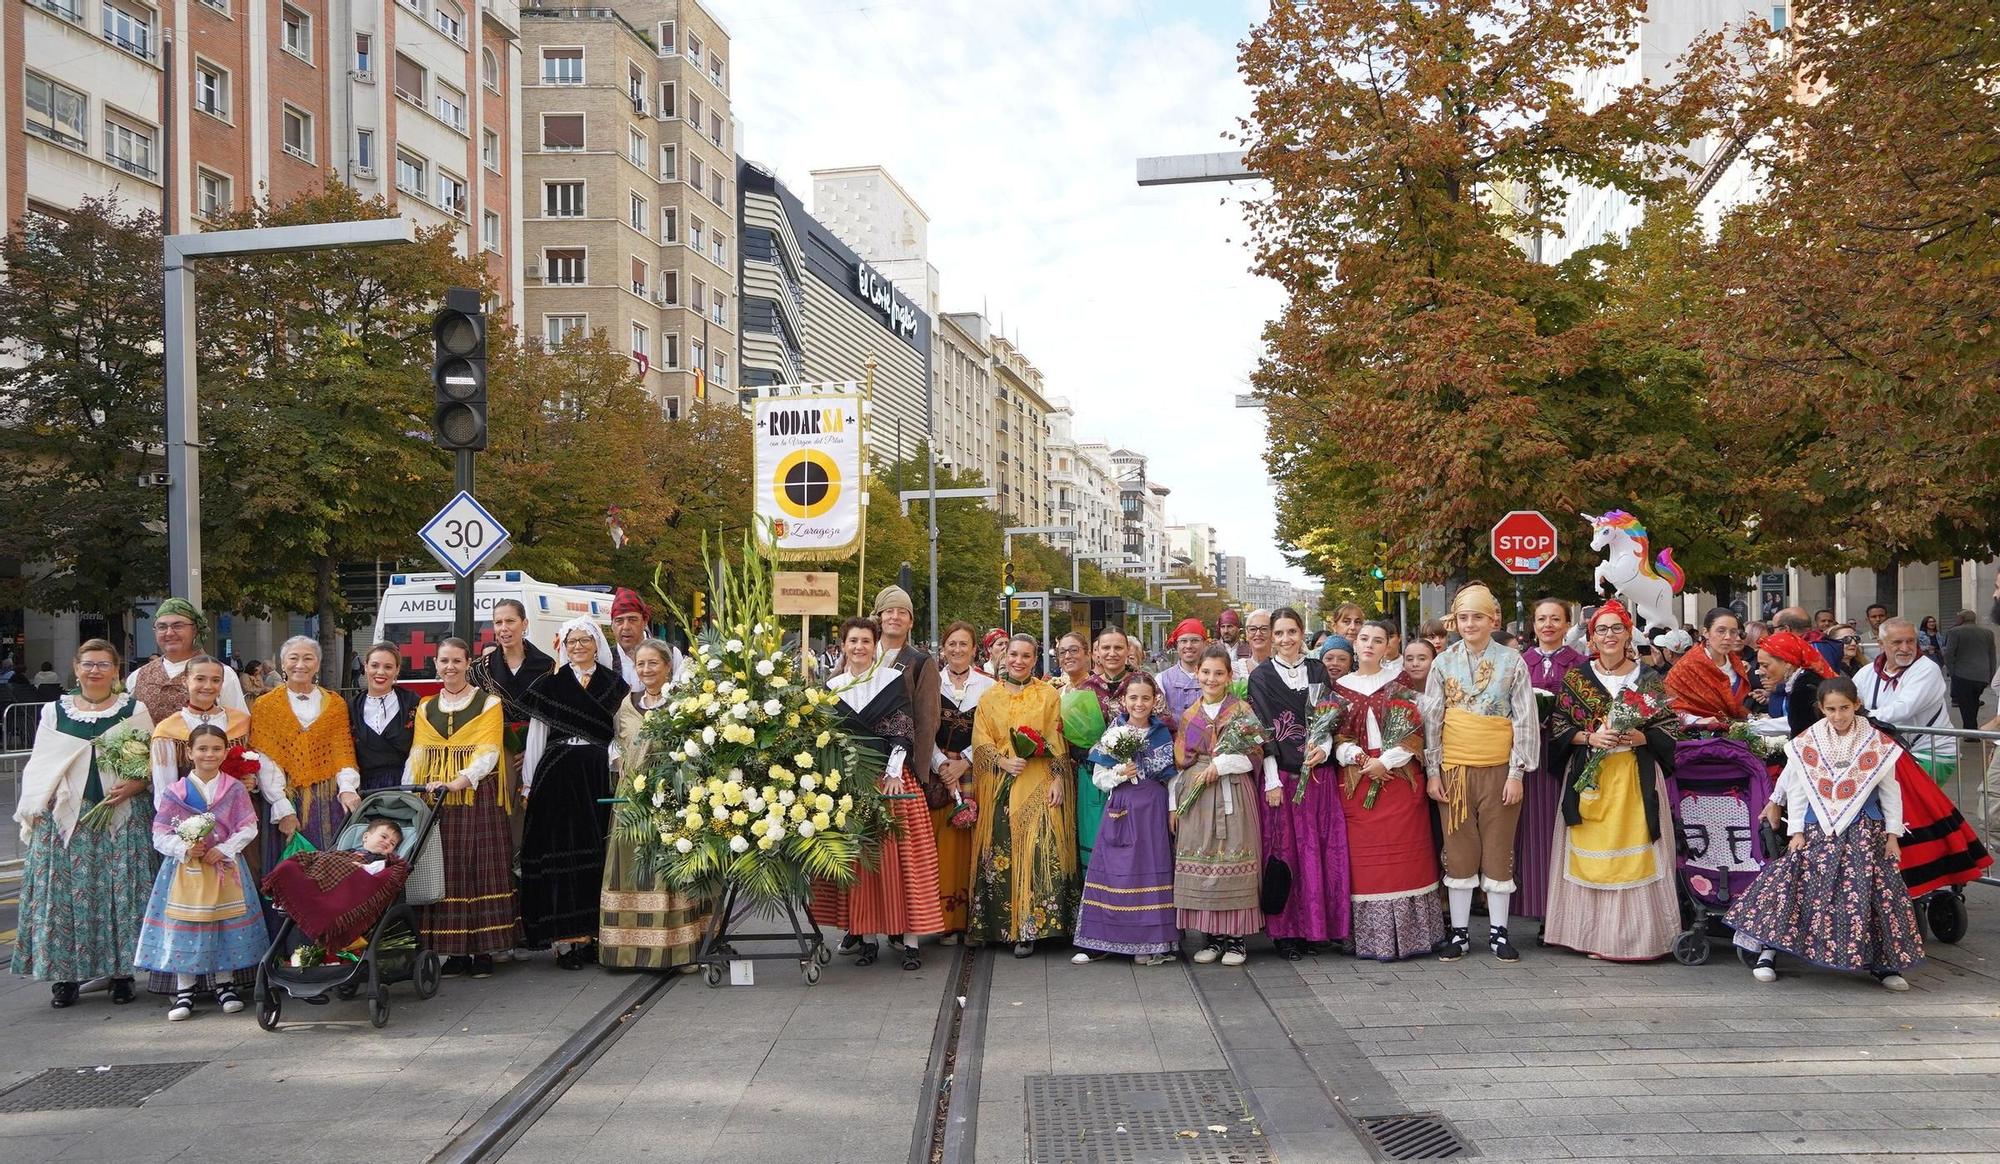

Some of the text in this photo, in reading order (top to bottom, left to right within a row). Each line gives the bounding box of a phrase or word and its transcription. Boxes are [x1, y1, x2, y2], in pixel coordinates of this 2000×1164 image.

[859, 263, 869, 298] El
[870, 273, 890, 314] Corte
[770, 409, 843, 436] RODARSA
[788, 436, 812, 447] Virgen
[813, 437, 823, 445] del
[824, 435, 844, 445] Pilar
[445, 520, 483, 548] 30
[790, 522, 841, 539] Zaragoza
[1500, 536, 1549, 549] STOP
[400, 598, 503, 611] AMBULNCI
